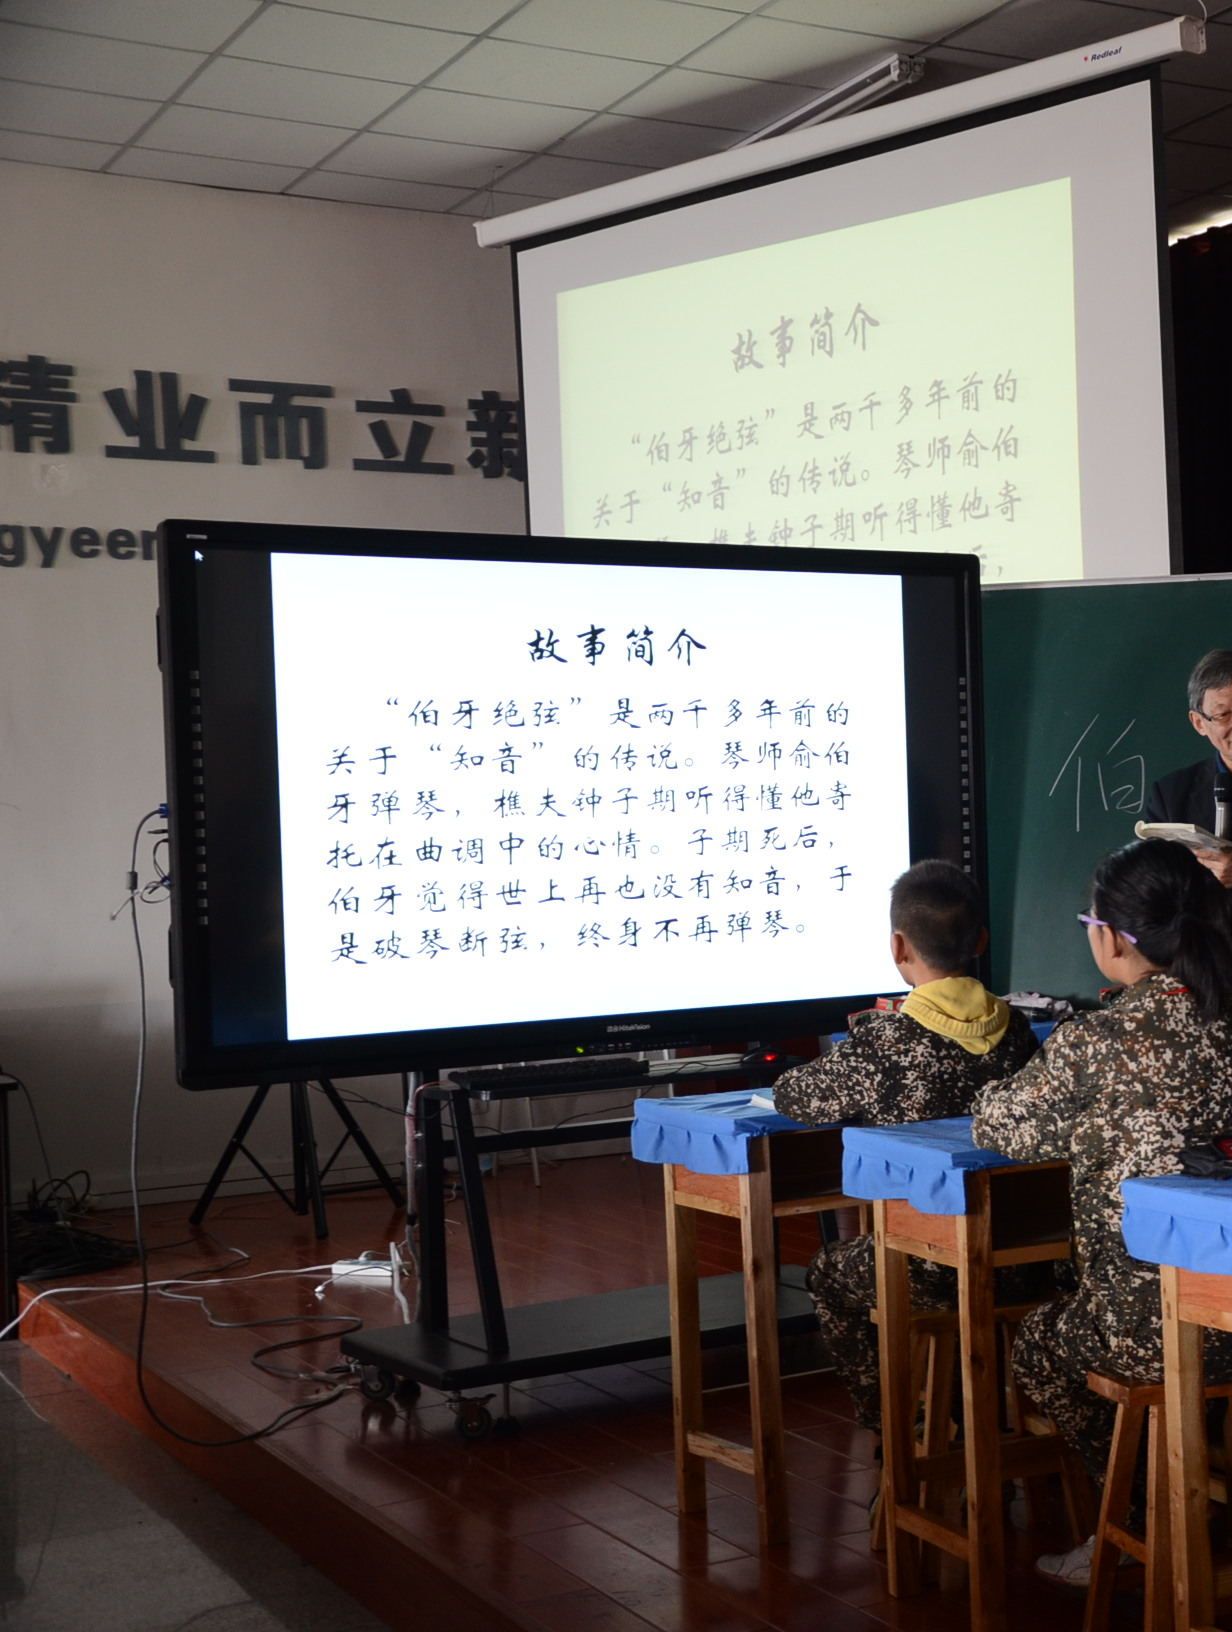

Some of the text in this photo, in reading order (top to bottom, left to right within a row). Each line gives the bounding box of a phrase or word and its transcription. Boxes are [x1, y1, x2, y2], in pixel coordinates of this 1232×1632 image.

[730, 301, 881, 374] 故事简介
[526, 623, 707, 667] 故事简介
